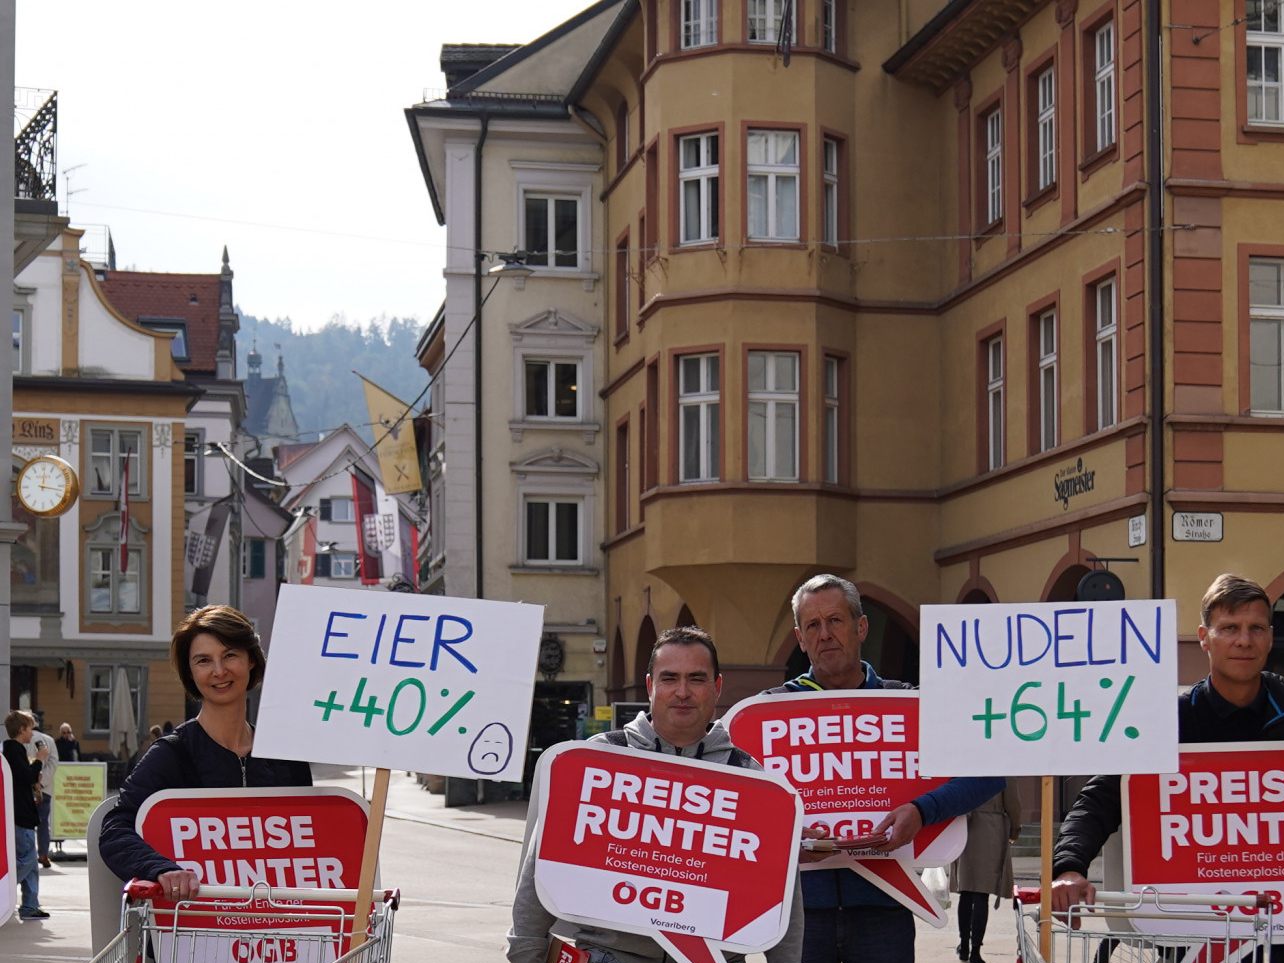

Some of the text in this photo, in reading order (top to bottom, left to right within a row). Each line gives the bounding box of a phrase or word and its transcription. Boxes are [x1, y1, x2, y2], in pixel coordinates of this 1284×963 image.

[1054, 467, 1095, 511] Sagmeister
[1180, 514, 1214, 528] Römer
[321, 611, 478, 674] EIER
[937, 606, 1161, 670] NUDELN
[313, 677, 476, 736] +40%
[972, 675, 1139, 742] +64%
[761, 714, 906, 756] PREISE
[580, 766, 740, 820] PREISE
[804, 797, 891, 811] ostenexplosion!
[817, 786, 834, 797] ein
[837, 785, 866, 795] Ende
[868, 784, 888, 795] der
[170, 815, 316, 858] PREISE
[573, 802, 761, 862] RUNTER
[605, 856, 708, 883] Kostenexplosion!
[607, 842, 707, 869] Für ein Ende der
[1197, 852, 1217, 863] Für
[1220, 851, 1238, 862] ein
[1242, 851, 1273, 862] Ende
[650, 917, 696, 933] Vorarlberg
